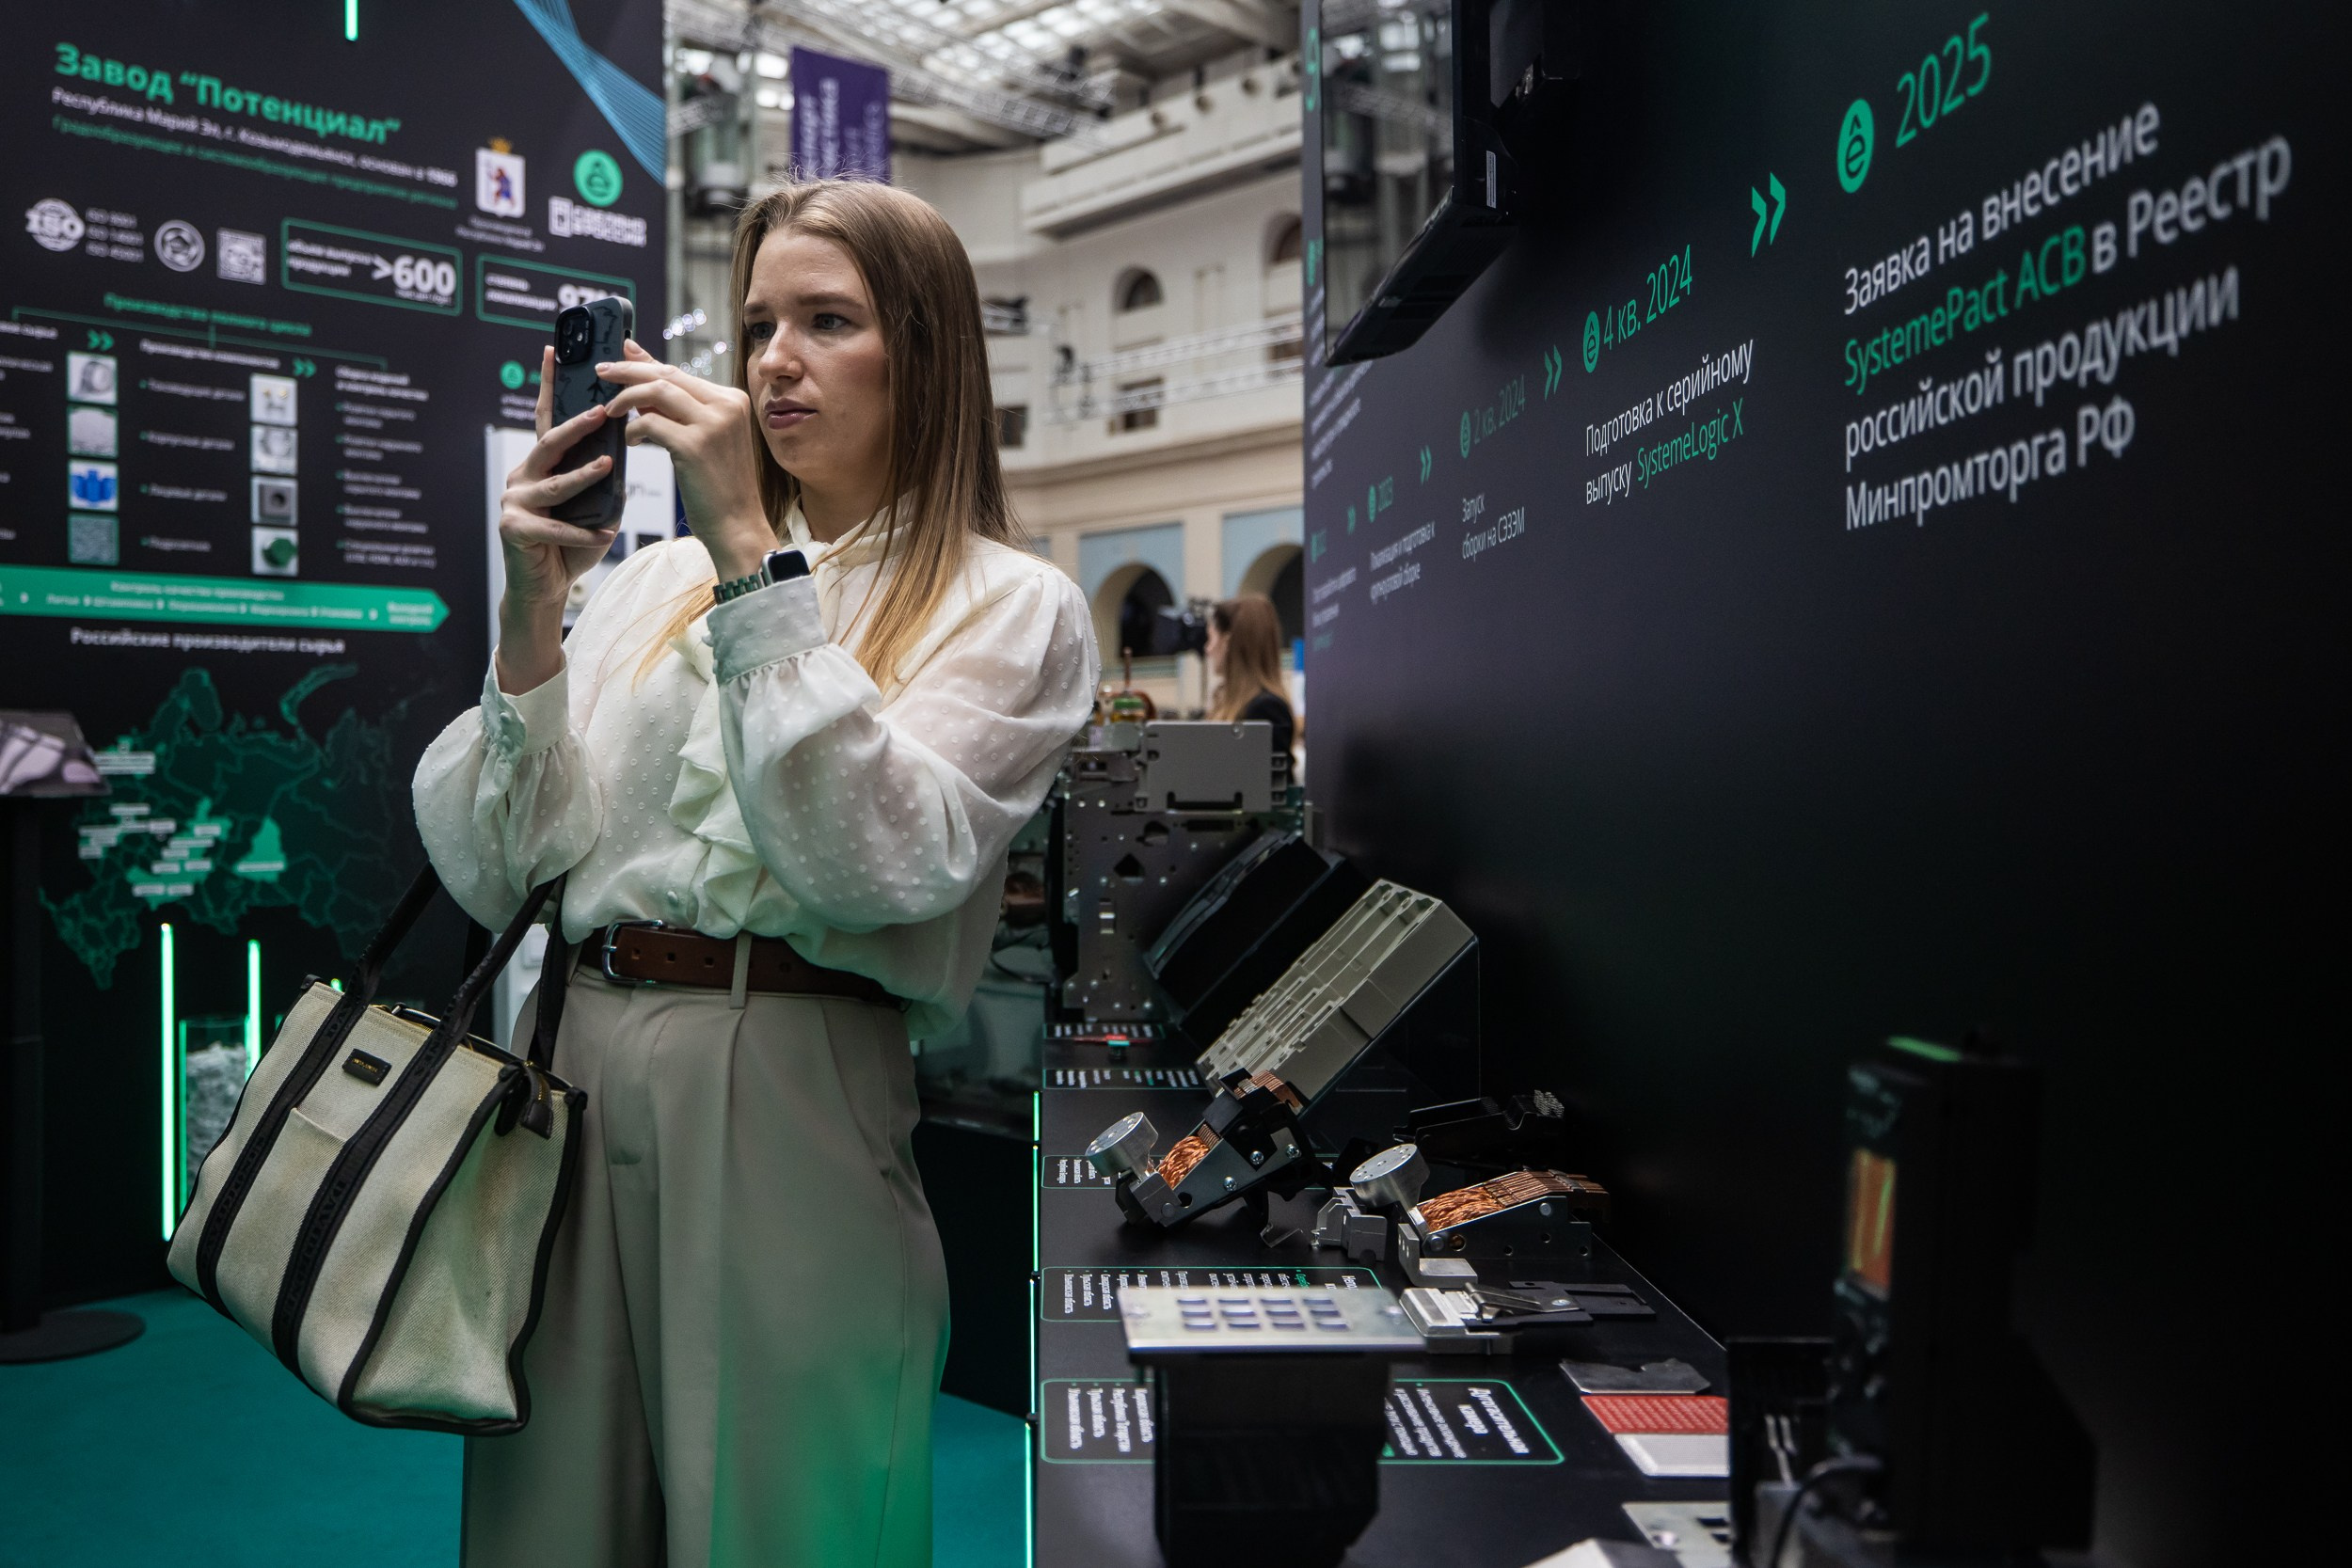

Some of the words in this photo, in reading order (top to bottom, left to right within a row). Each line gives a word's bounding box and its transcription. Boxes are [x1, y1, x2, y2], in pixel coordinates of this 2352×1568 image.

[52, 87, 145, 121] Республика
[55, 42, 174, 105] Завод
[1895, 12, 1993, 149] 2025
[1844, 234, 1931, 315] Заявка
[1938, 210, 1974, 265] на
[1982, 101, 2160, 242] внесение
[1603, 304, 1614, 351] 4
[1618, 301, 1642, 344] кв.
[1647, 244, 1692, 325] 2024
[1845, 269, 2008, 395] SystemePact
[2092, 222, 2119, 274] в
[2128, 135, 2294, 259] Реестр
[1473, 414, 1481, 445] 2
[1499, 374, 1526, 427] 2024
[1586, 397, 1653, 457] Подготовка
[1656, 392, 1664, 418] к
[1666, 339, 1754, 416] серийному
[1846, 347, 2004, 472] российской
[2014, 264, 2240, 406] продукции
[1586, 461, 1632, 506] выпуску
[1637, 408, 1729, 489] SystemeLogic
[1847, 428, 2067, 531] Минпромторга
[2077, 394, 2136, 467] РФ
[1462, 493, 1486, 523] Запуск
[1462, 528, 1486, 562] сборки
[1486, 527, 1497, 549] на
[70, 626, 171, 649] Российские
[1457, 1404, 1488, 1434] камера
[1468, 1387, 1530, 1453] Дугогасительная
